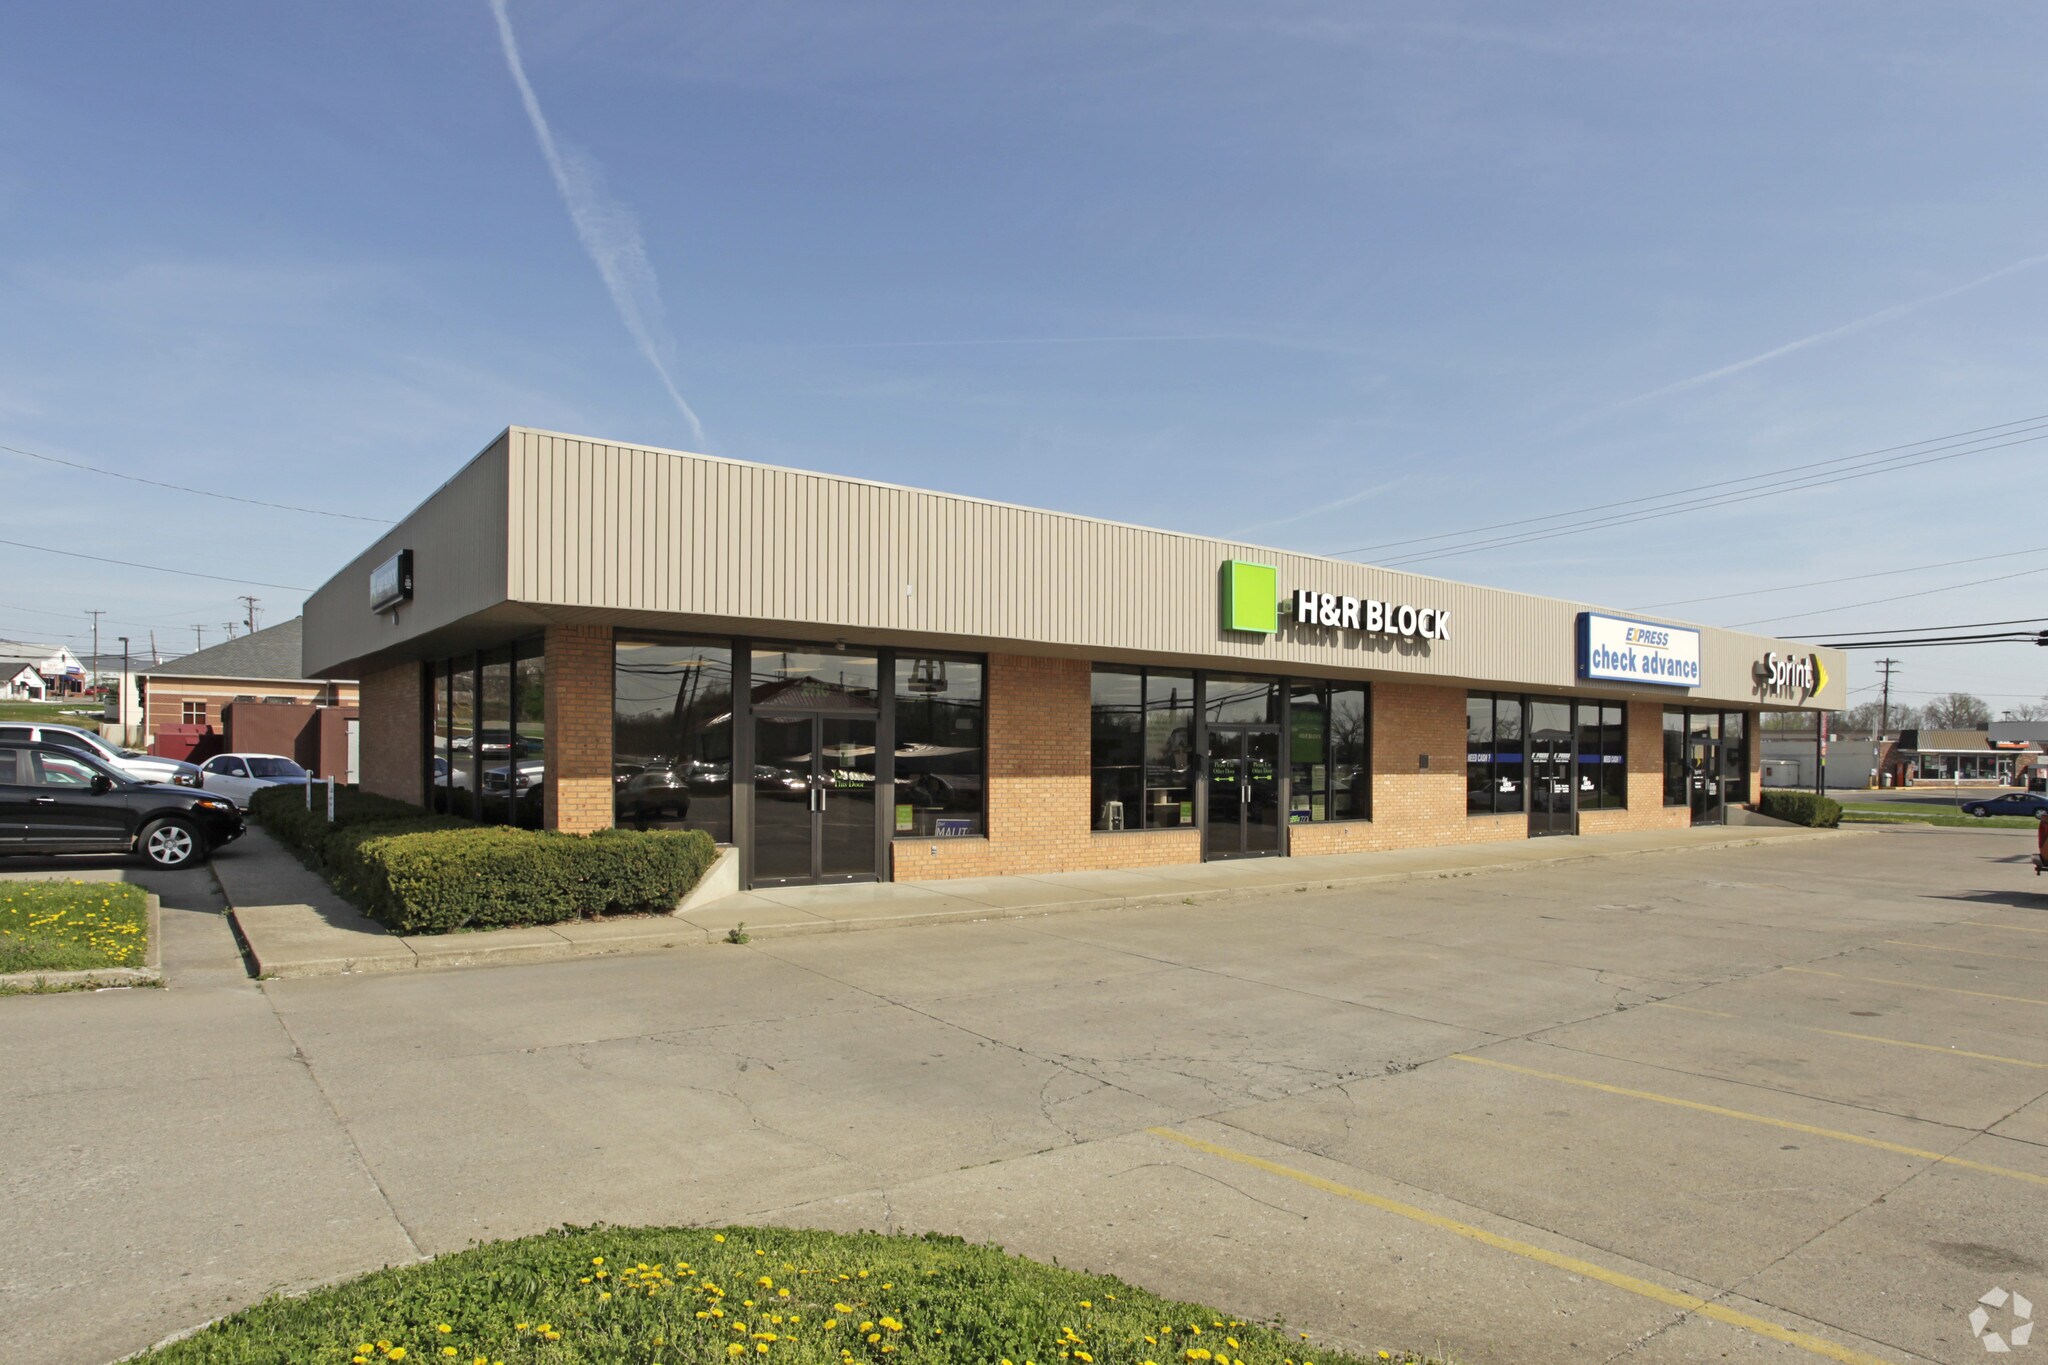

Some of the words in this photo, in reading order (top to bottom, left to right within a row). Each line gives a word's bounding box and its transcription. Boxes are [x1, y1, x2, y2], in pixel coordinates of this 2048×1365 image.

[1297, 589, 1360, 629] H&R
[1366, 600, 1450, 640] BLOCK
[1625, 627, 1669, 646] EXPRESS
[1592, 643, 1637, 672] check
[1642, 651, 1698, 679] advance
[1767, 651, 1811, 694] Sprint
[935, 827, 974, 836] MALIT
